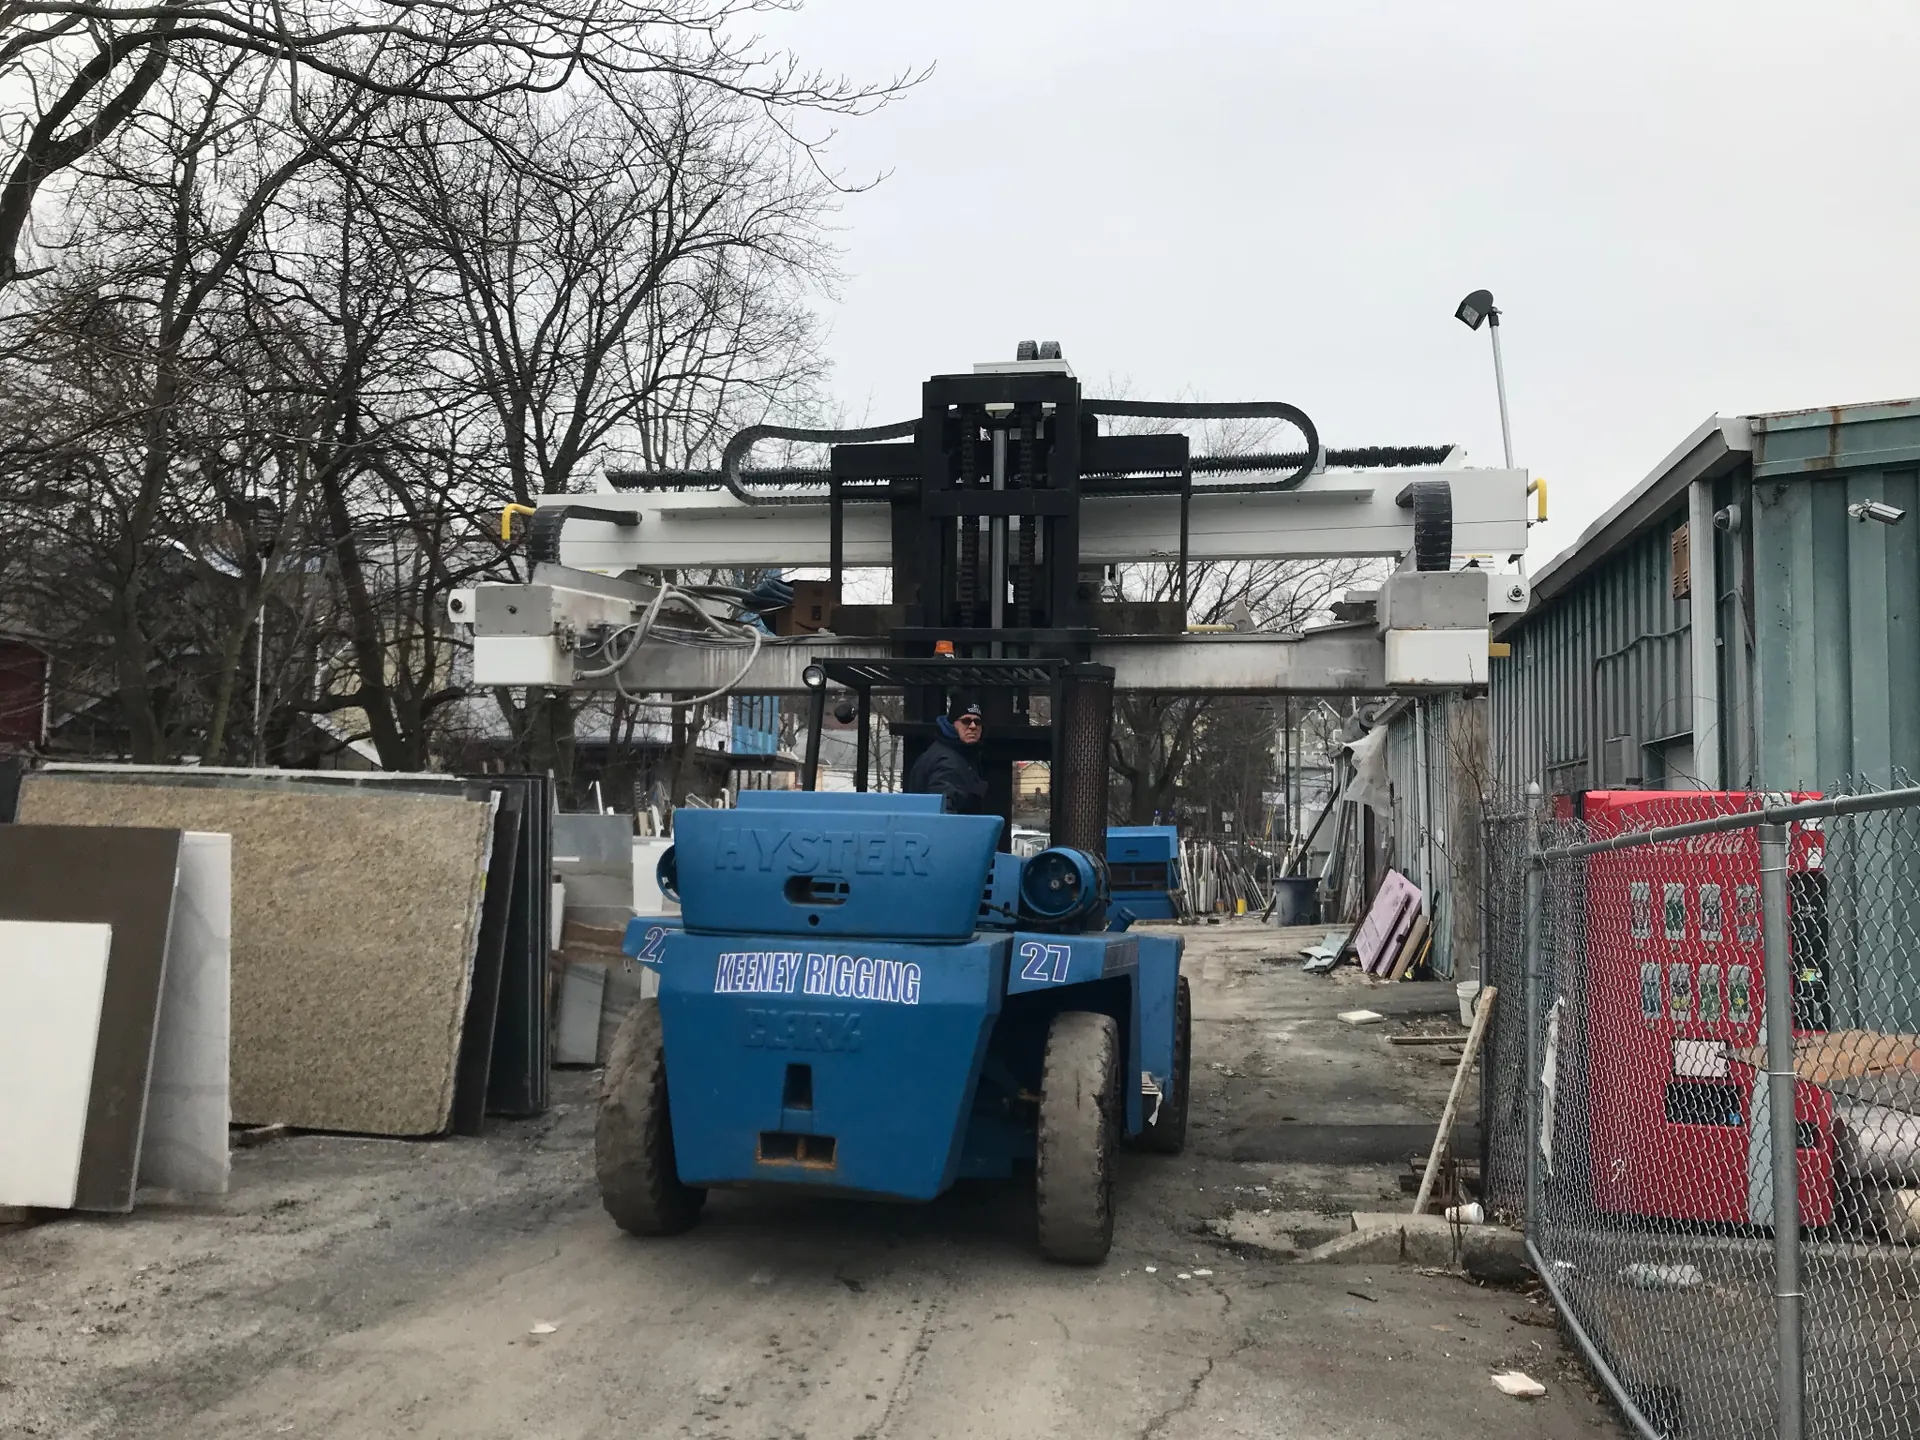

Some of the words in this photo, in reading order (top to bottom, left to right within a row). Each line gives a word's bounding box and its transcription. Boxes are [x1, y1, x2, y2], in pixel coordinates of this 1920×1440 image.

[714, 827, 930, 877] HYSTER
[714, 952, 803, 993] KEENEY
[803, 953, 921, 1005] RIGGING
[1020, 941, 1072, 983] 27
